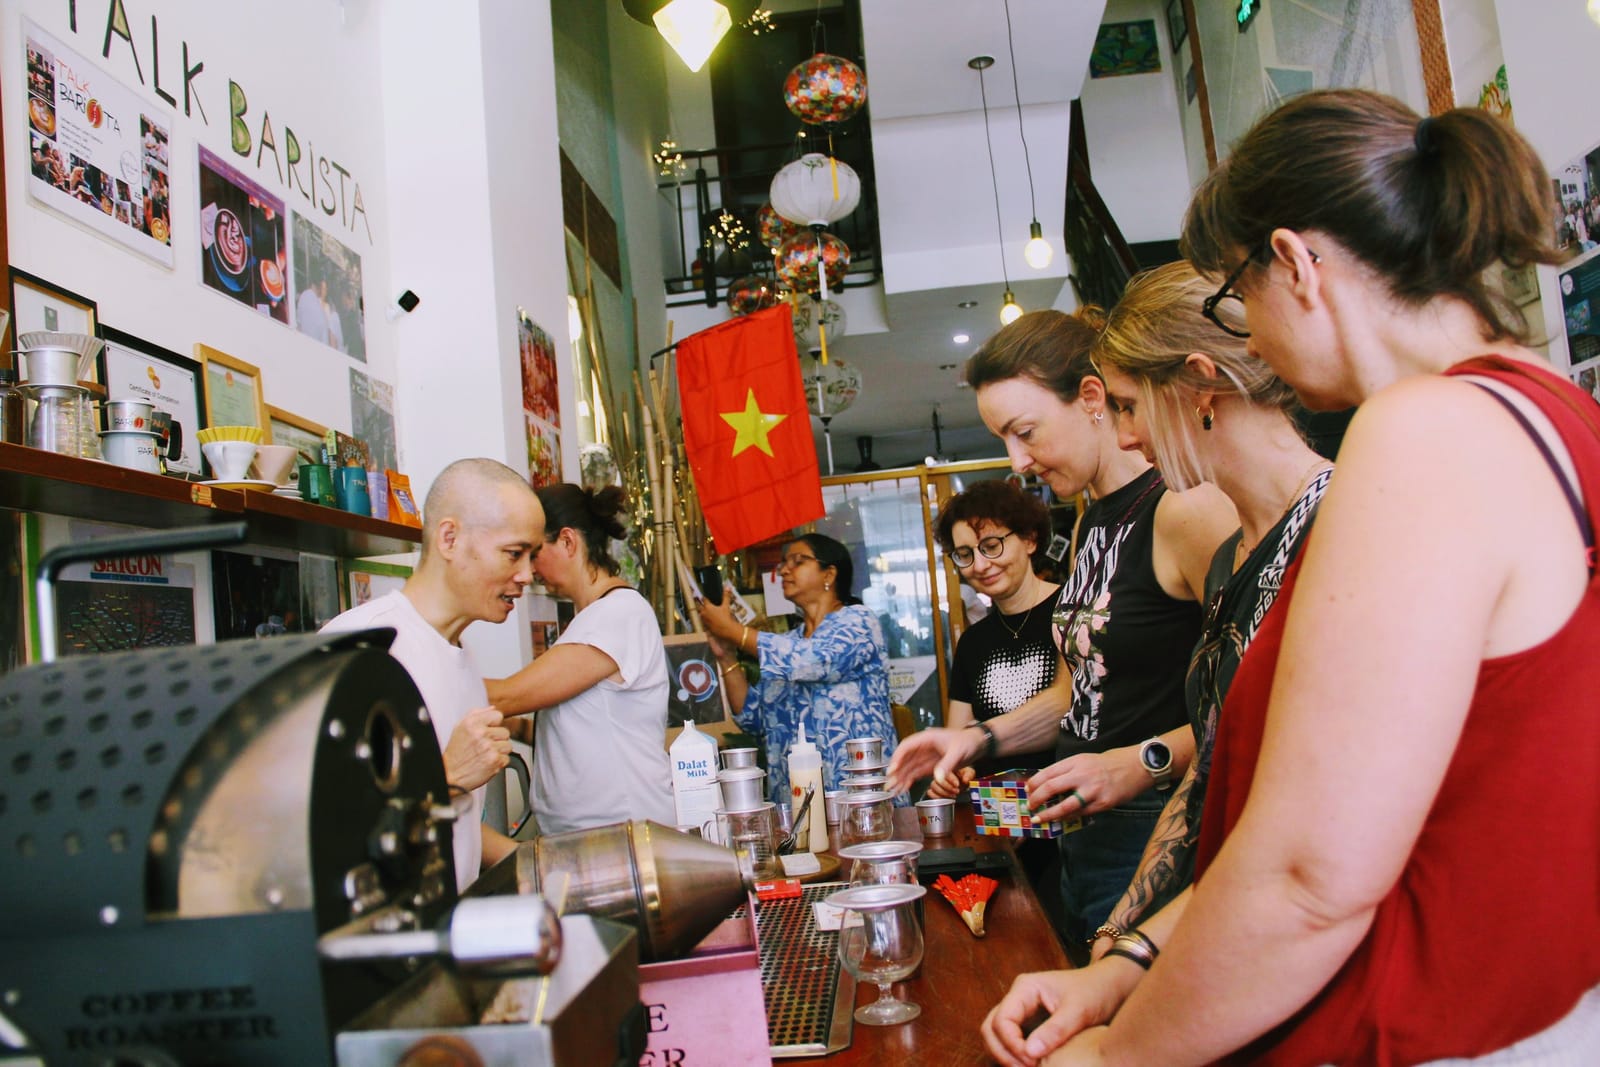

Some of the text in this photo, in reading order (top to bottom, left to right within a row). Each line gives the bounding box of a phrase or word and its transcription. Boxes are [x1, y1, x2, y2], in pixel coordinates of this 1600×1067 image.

[94, 553, 162, 576] SAIGON
[677, 760, 708, 770] Dalat
[687, 769, 709, 778] Milk
[81, 986, 257, 1018] COFFEE
[64, 1015, 280, 1050] ROASTER
